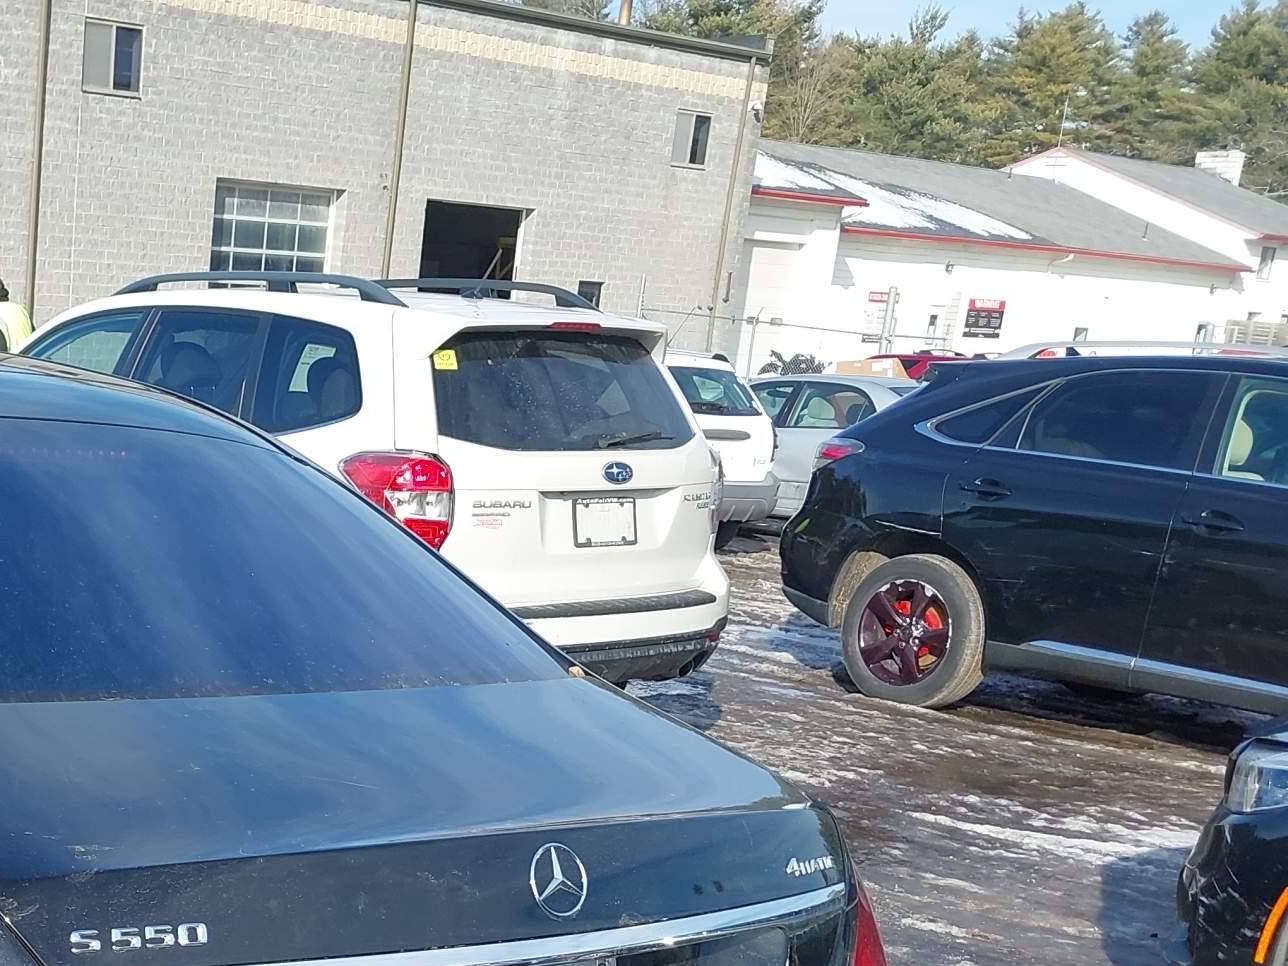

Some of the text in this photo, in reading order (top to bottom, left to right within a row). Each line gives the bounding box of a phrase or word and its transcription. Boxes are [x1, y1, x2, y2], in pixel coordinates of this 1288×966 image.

[472, 500, 531, 509] SUBARU
[69, 922, 208, 954] S 550
